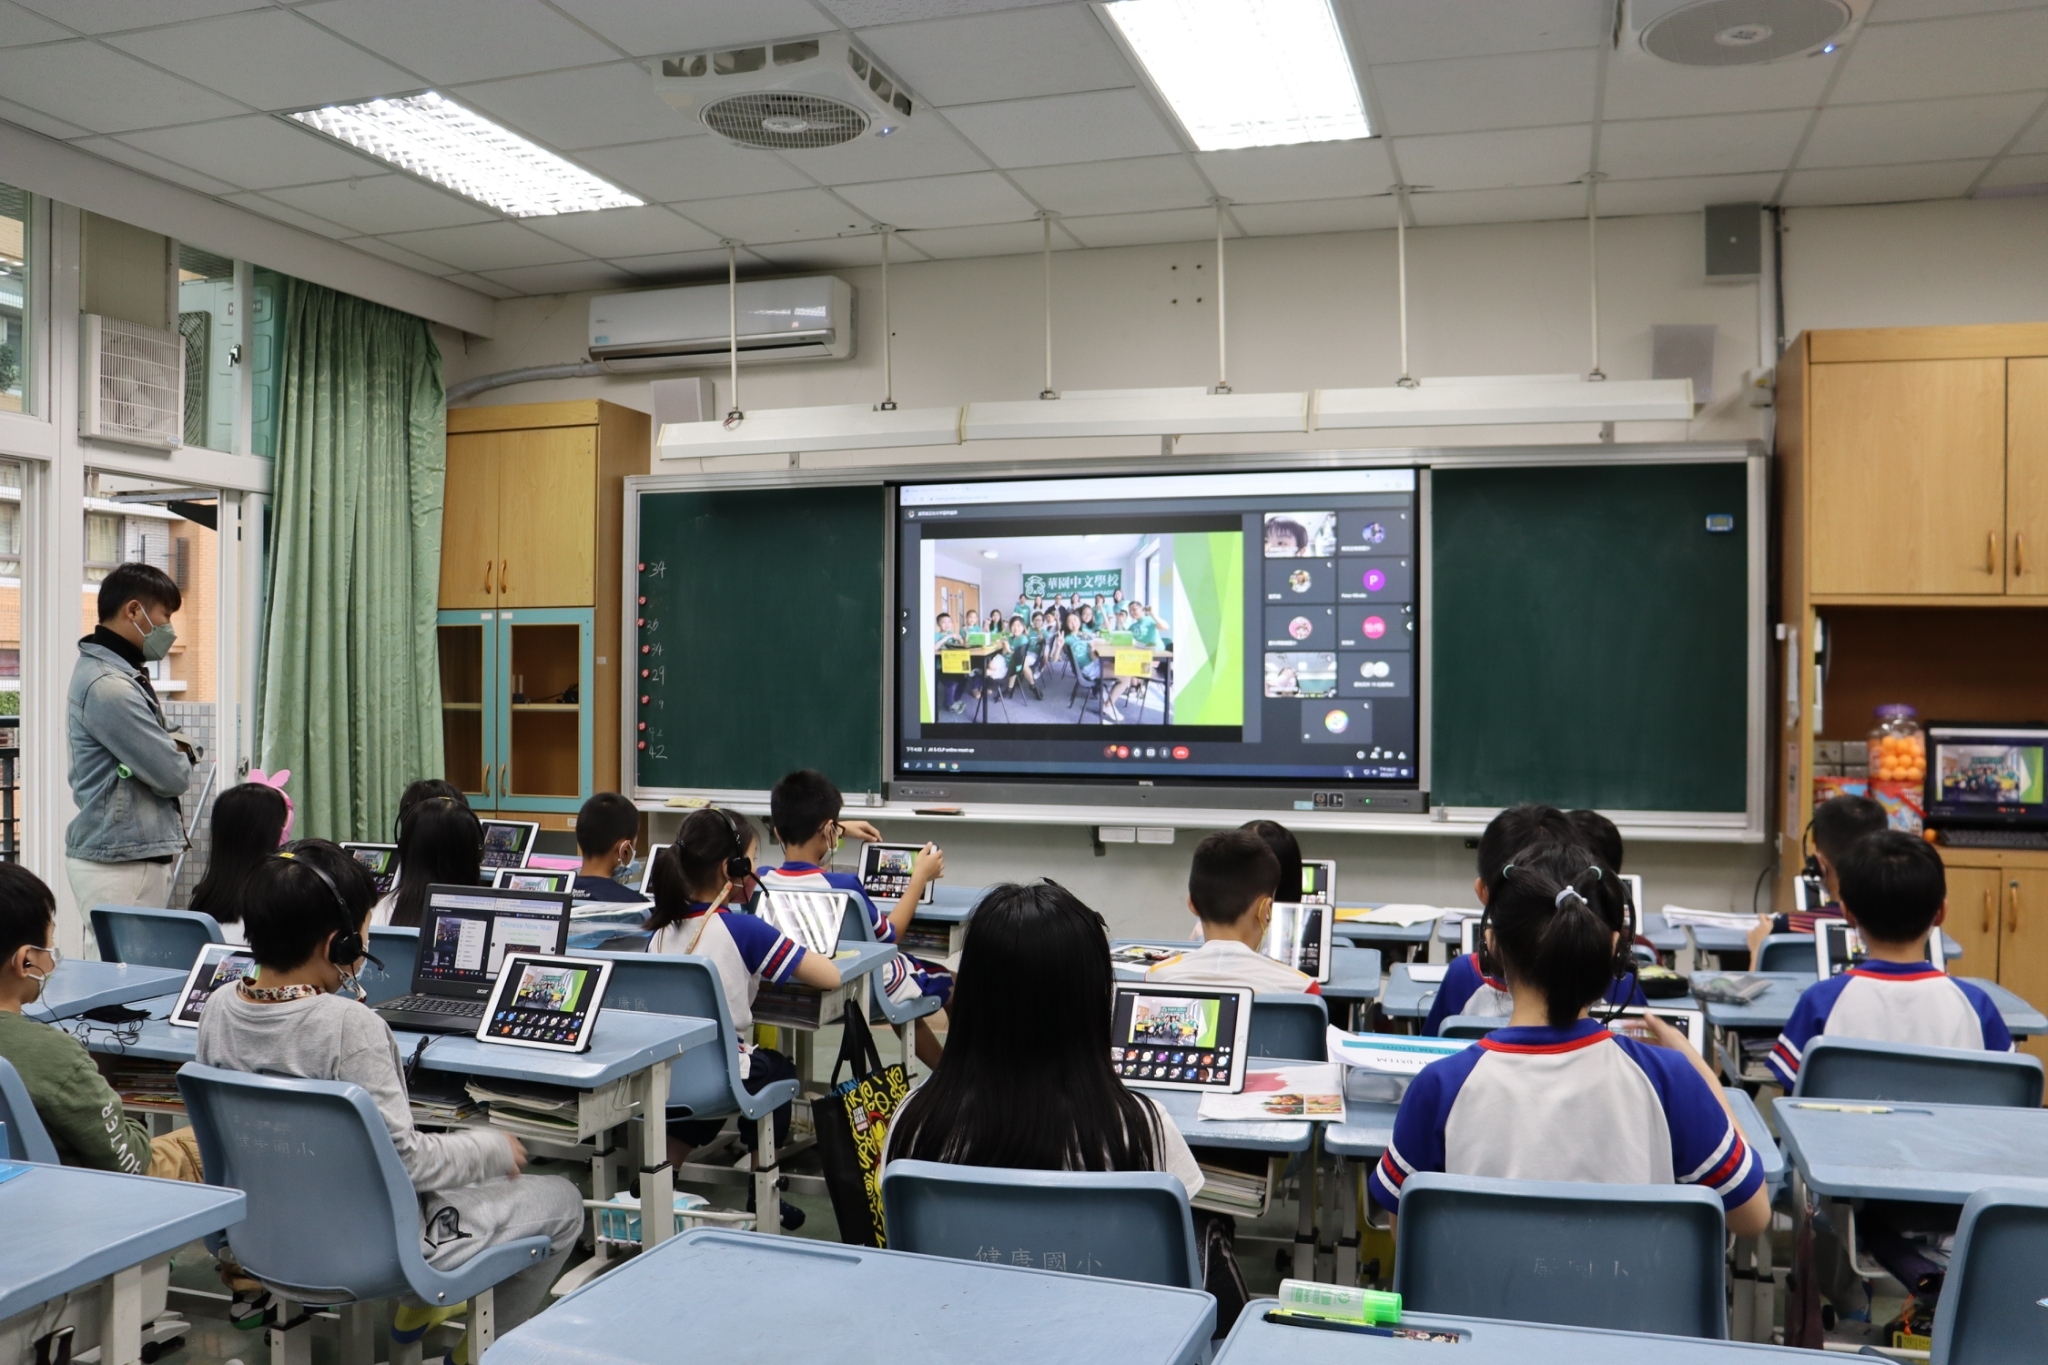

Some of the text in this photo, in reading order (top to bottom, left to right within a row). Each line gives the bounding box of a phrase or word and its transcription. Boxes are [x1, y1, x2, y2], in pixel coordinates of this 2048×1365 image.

[649, 561, 667, 578] 34
[1048, 573, 1120, 590] 華園中文學校
[1369, 575, 1379, 585] P
[652, 665, 665, 686] 29
[649, 745, 668, 759] 42
[500, 920, 553, 931] Chinese New Year
[975, 1245, 1102, 1276] 健康國小
